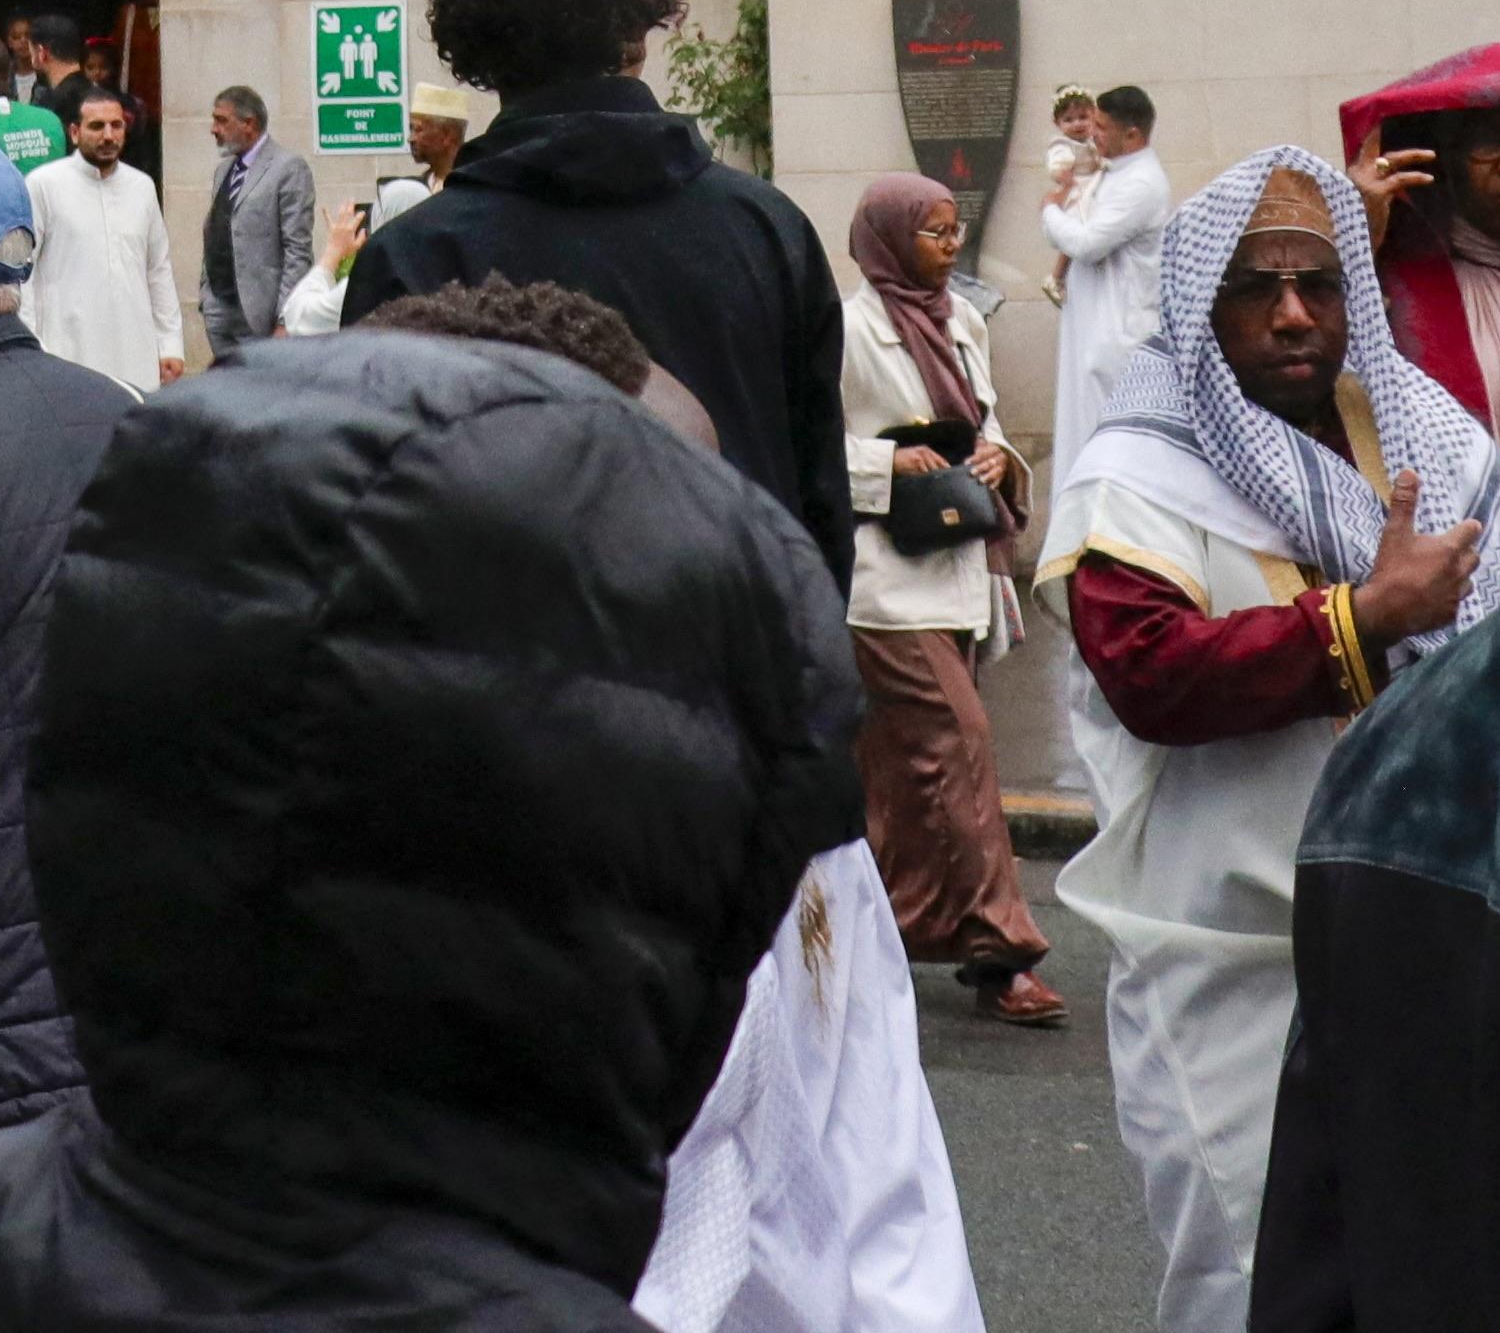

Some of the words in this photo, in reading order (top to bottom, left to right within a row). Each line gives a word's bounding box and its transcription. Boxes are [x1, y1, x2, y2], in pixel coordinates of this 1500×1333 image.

[345, 108, 376, 119] POINT
[354, 121, 368, 131] DE
[321, 133, 402, 144] RASSEMBLEMENT
